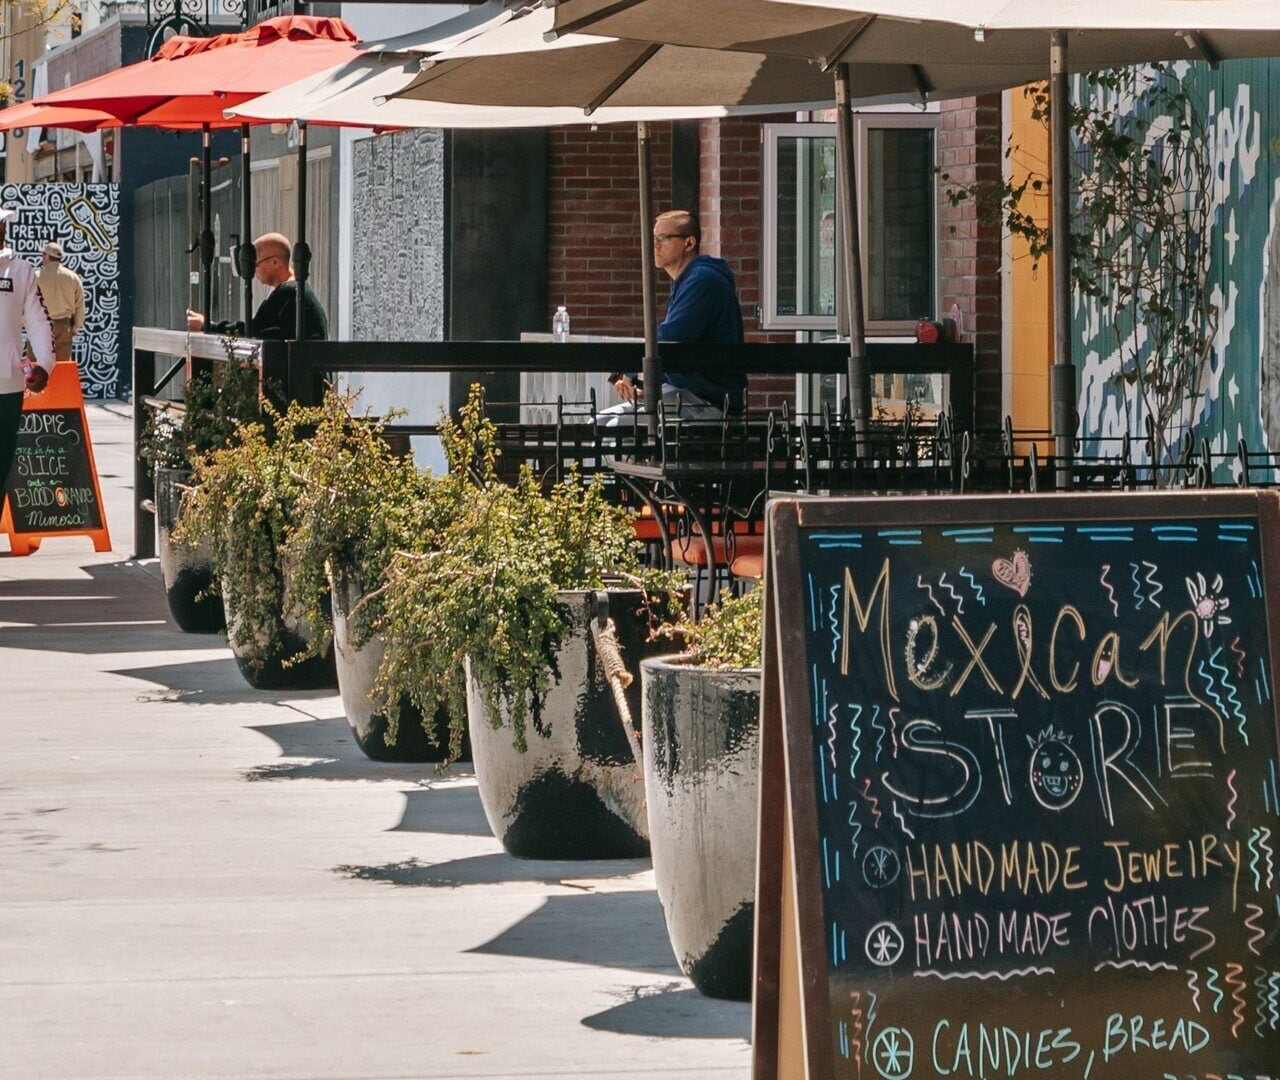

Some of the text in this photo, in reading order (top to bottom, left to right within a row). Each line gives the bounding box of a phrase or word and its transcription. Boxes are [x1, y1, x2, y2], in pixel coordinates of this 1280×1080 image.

[20, 210, 43, 225] IT'S
[12, 225, 56, 239] PRETTY
[43, 414, 73, 438] PIE
[17, 455, 69, 476] SLICE
[841, 557, 1225, 708] Mexican
[881, 697, 1216, 827] STORE
